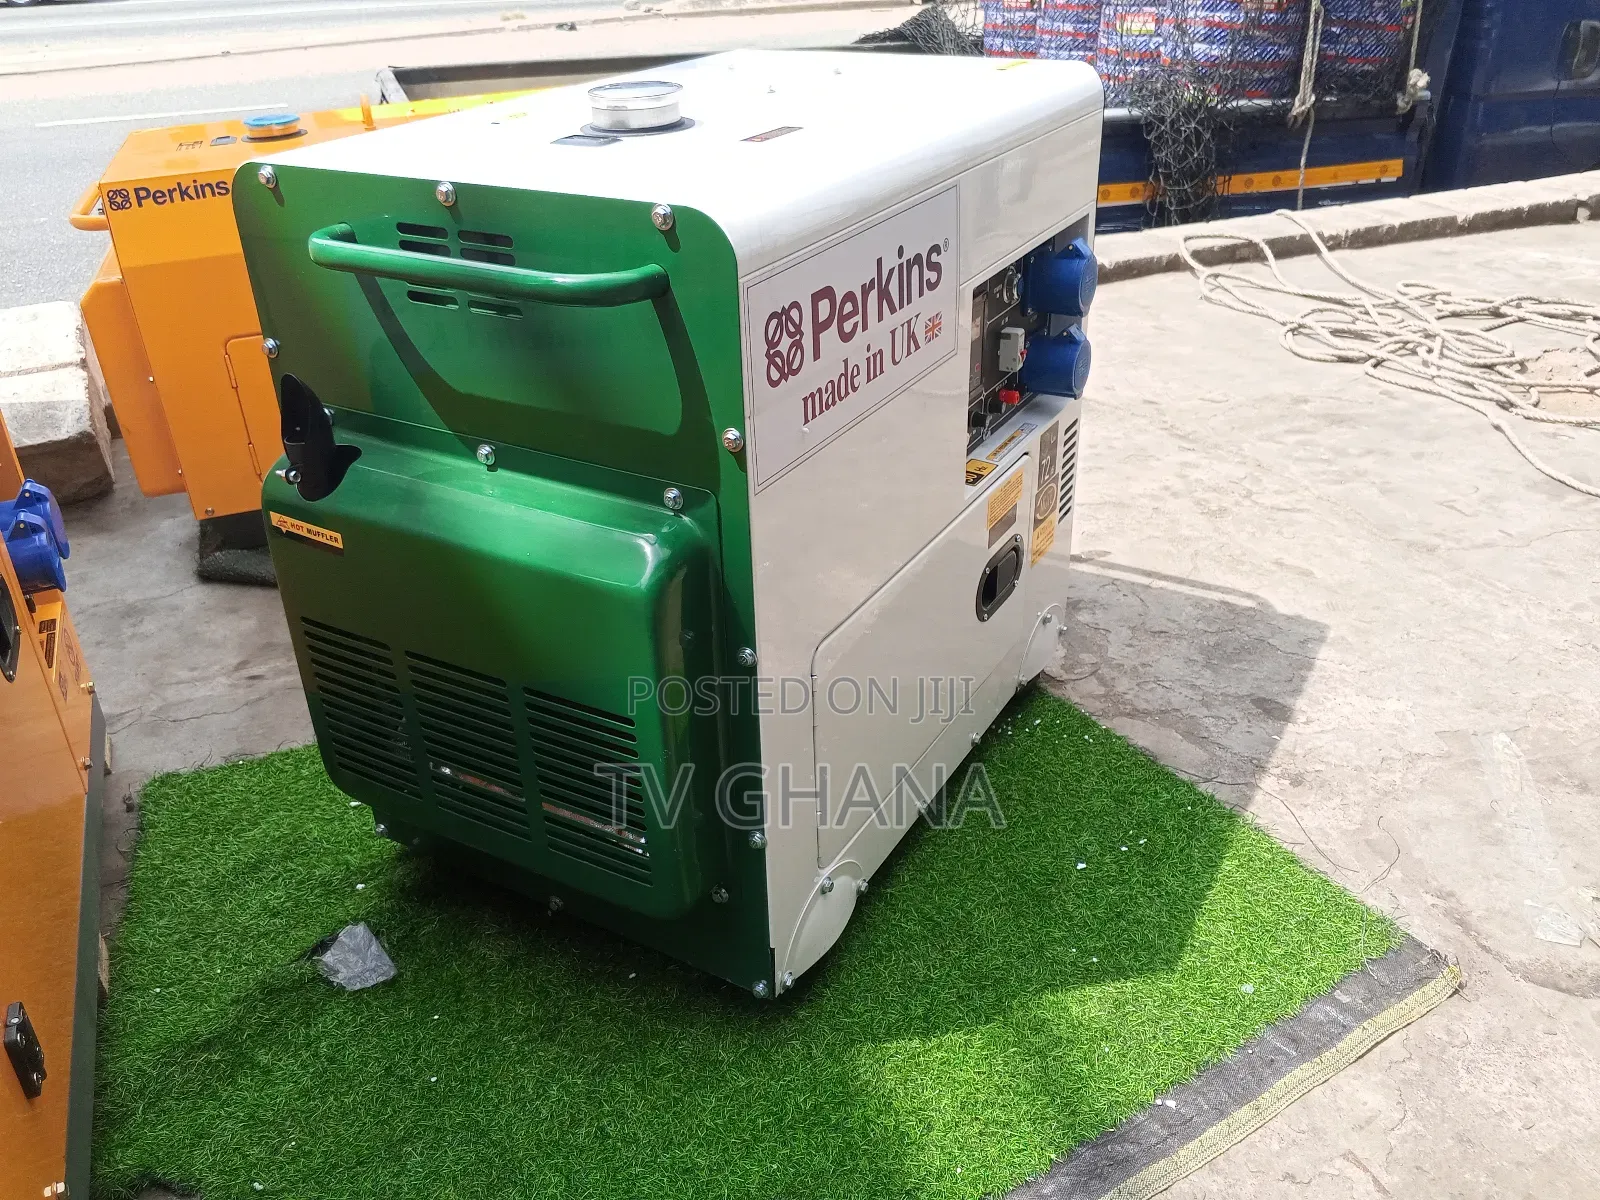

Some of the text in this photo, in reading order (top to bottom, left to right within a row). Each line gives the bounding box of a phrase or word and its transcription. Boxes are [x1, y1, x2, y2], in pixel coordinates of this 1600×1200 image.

[133, 179, 231, 208] Perkins
[801, 311, 921, 426] made in UK
[1040, 455, 1051, 483] 72
[290, 522, 340, 544] HOT MUFFLER
